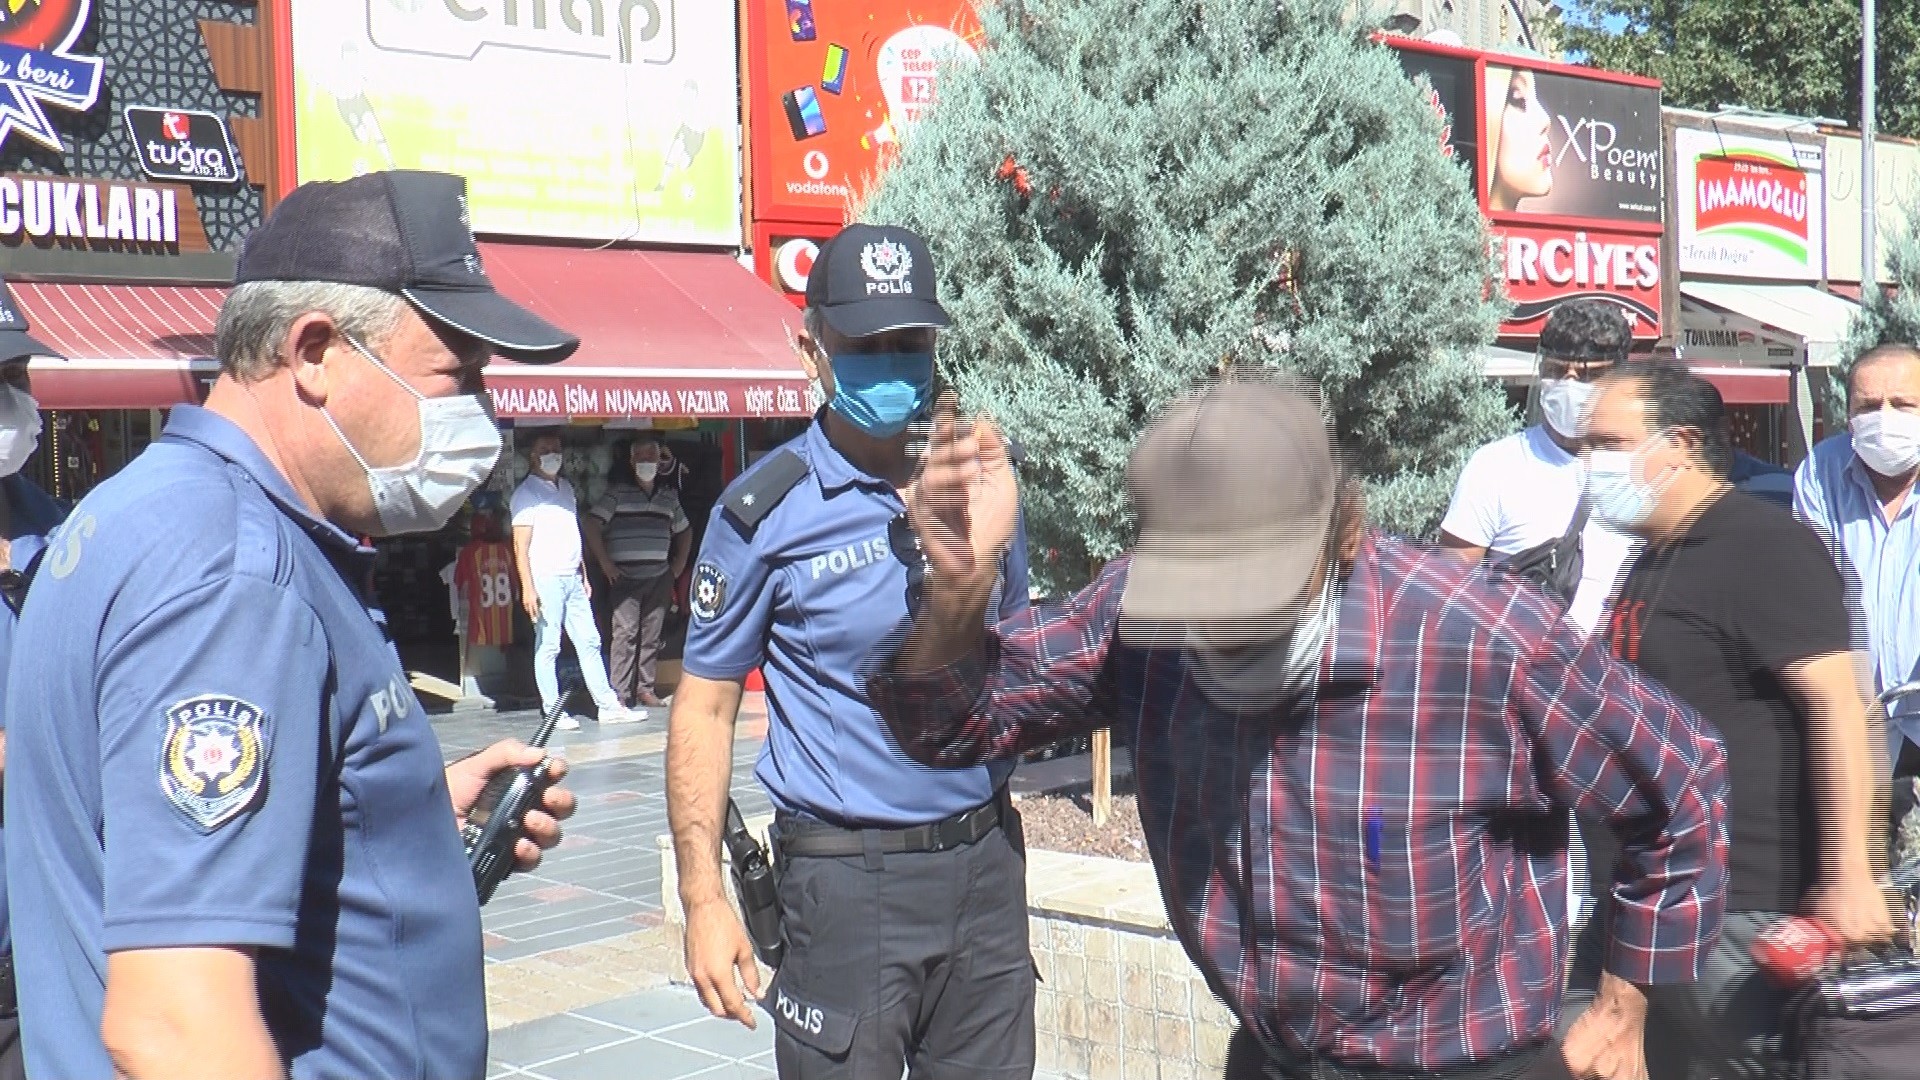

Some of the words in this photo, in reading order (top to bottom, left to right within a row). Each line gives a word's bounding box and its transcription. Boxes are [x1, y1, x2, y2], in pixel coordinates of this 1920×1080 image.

[17, 53, 75, 90] beri
[146, 140, 222, 174] tuğra
[786, 181, 849, 196] vodafone
[1591, 164, 1657, 190] Beauty
[0, 176, 176, 242] CUKLARI
[486, 388, 560, 414] MALARA
[565, 384, 599, 413] İSİM
[605, 389, 672, 413] NUMARA
[677, 390, 730, 413] YAZILIR
[777, 385, 801, 412] ÖZEL
[179, 700, 252, 726] POLİS
[775, 987, 824, 1034] POLIS
